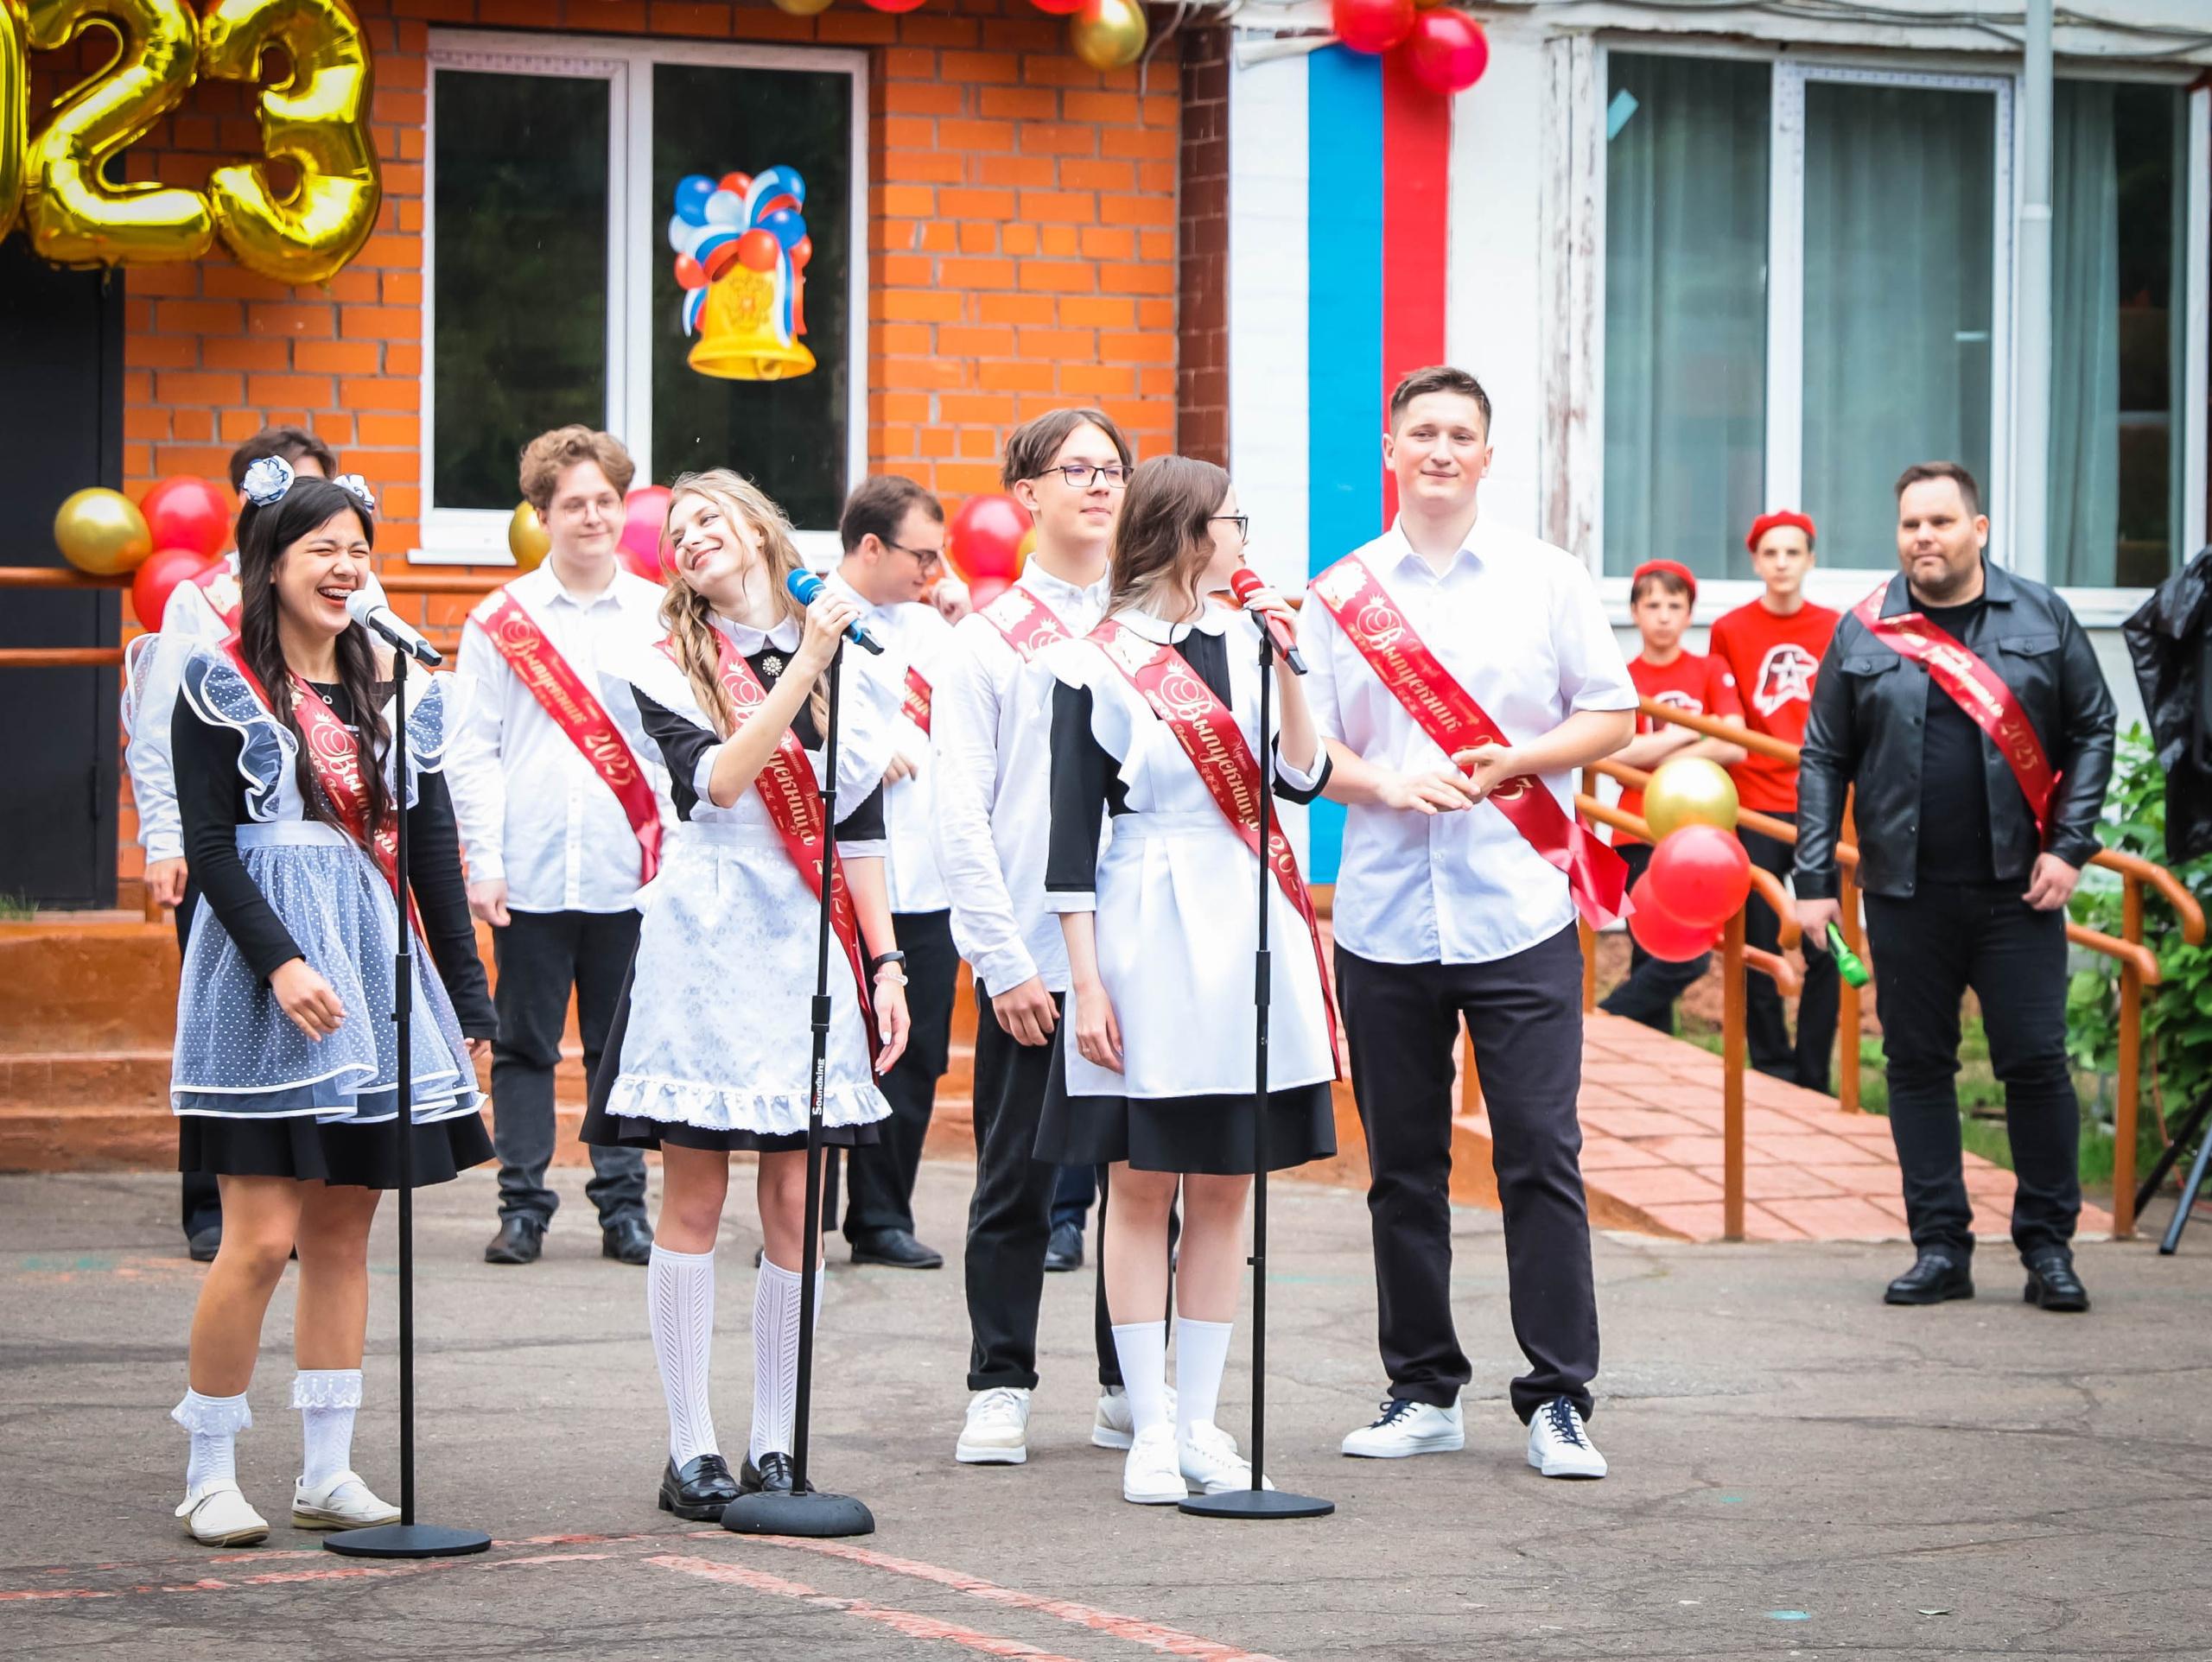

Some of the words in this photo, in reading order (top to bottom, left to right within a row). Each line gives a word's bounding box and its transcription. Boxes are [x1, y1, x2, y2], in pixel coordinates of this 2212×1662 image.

[0, 0, 381, 283] 23
[501, 618, 588, 725] Выпускник
[1357, 605, 1462, 733] Выпускник
[721, 672, 817, 847] Вускница
[1160, 673, 1260, 833] Выпускница
[811, 1057, 826, 1116] Soundking
